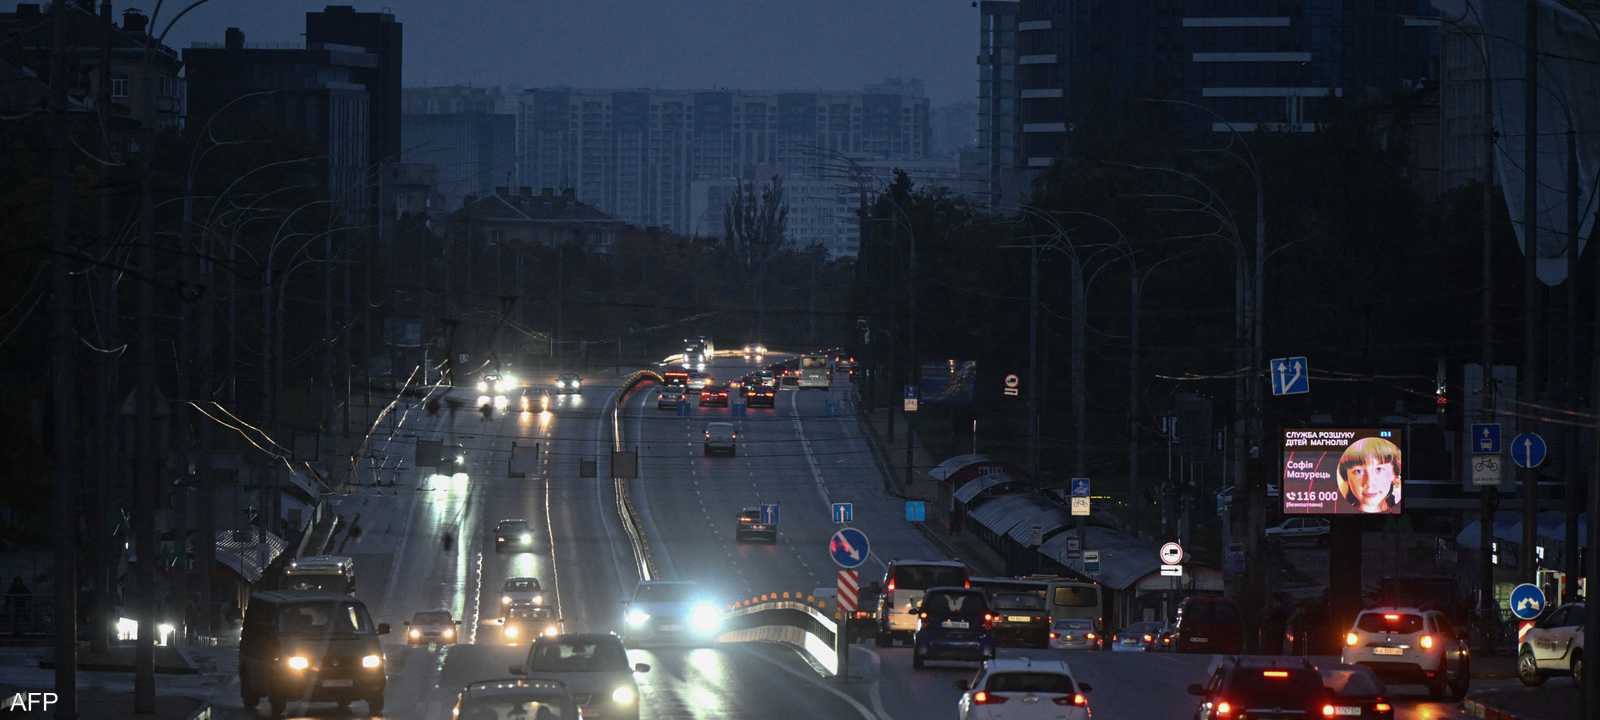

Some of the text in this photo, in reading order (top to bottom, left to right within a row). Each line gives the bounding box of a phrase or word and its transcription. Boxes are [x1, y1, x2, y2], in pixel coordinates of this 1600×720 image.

[1286, 439, 1307, 447] ДІТЕЙ
[1287, 461, 1313, 470] Софія
[1287, 471, 1330, 480] Мазурець
[1297, 492, 1338, 500] 116 000
